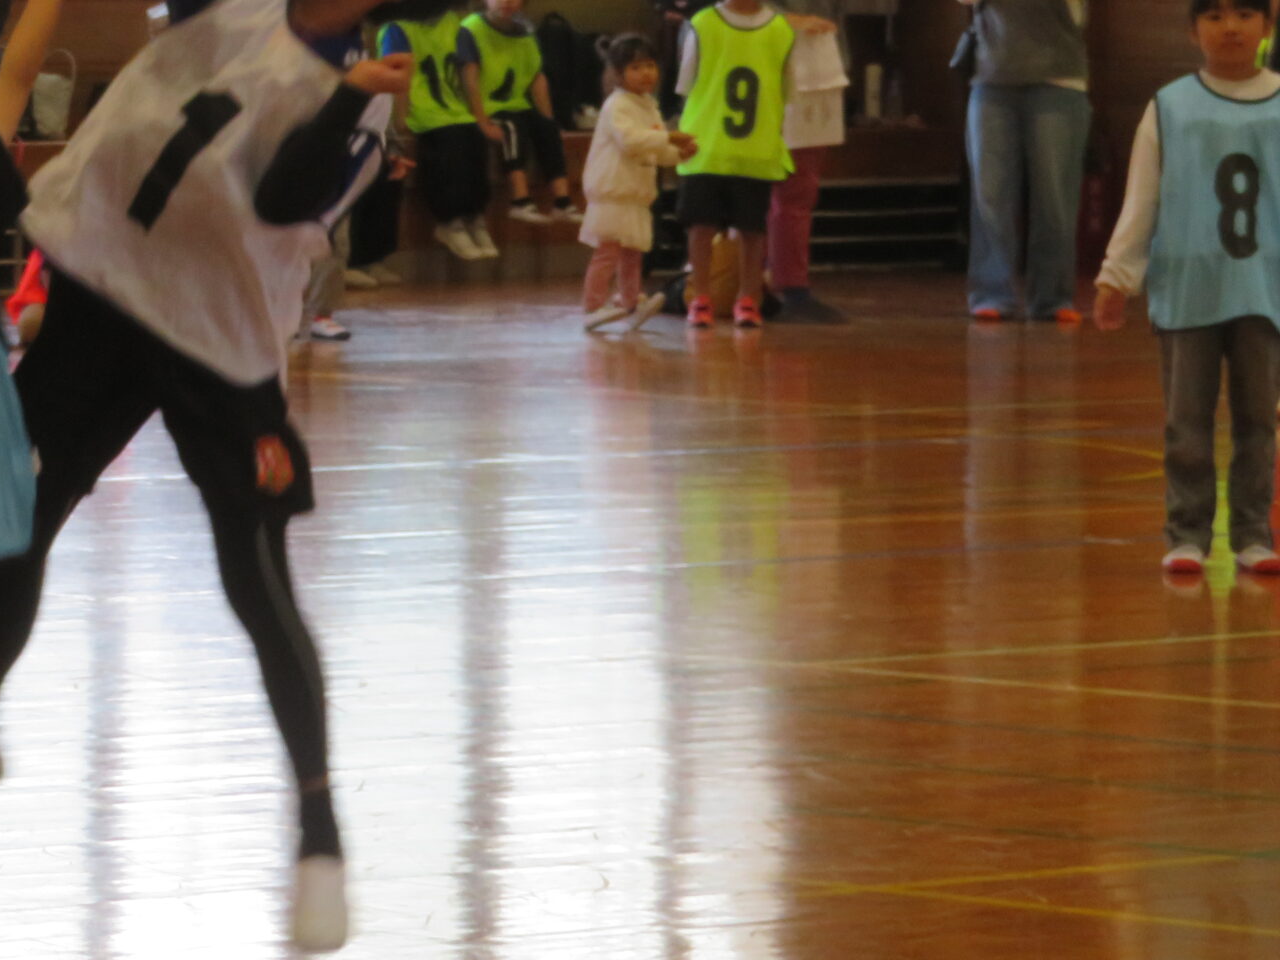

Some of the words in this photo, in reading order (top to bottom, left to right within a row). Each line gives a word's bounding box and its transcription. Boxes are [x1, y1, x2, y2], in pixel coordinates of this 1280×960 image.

[724, 67, 760, 139] 9
[129, 91, 242, 231] 1
[1215, 153, 1260, 259] 8
